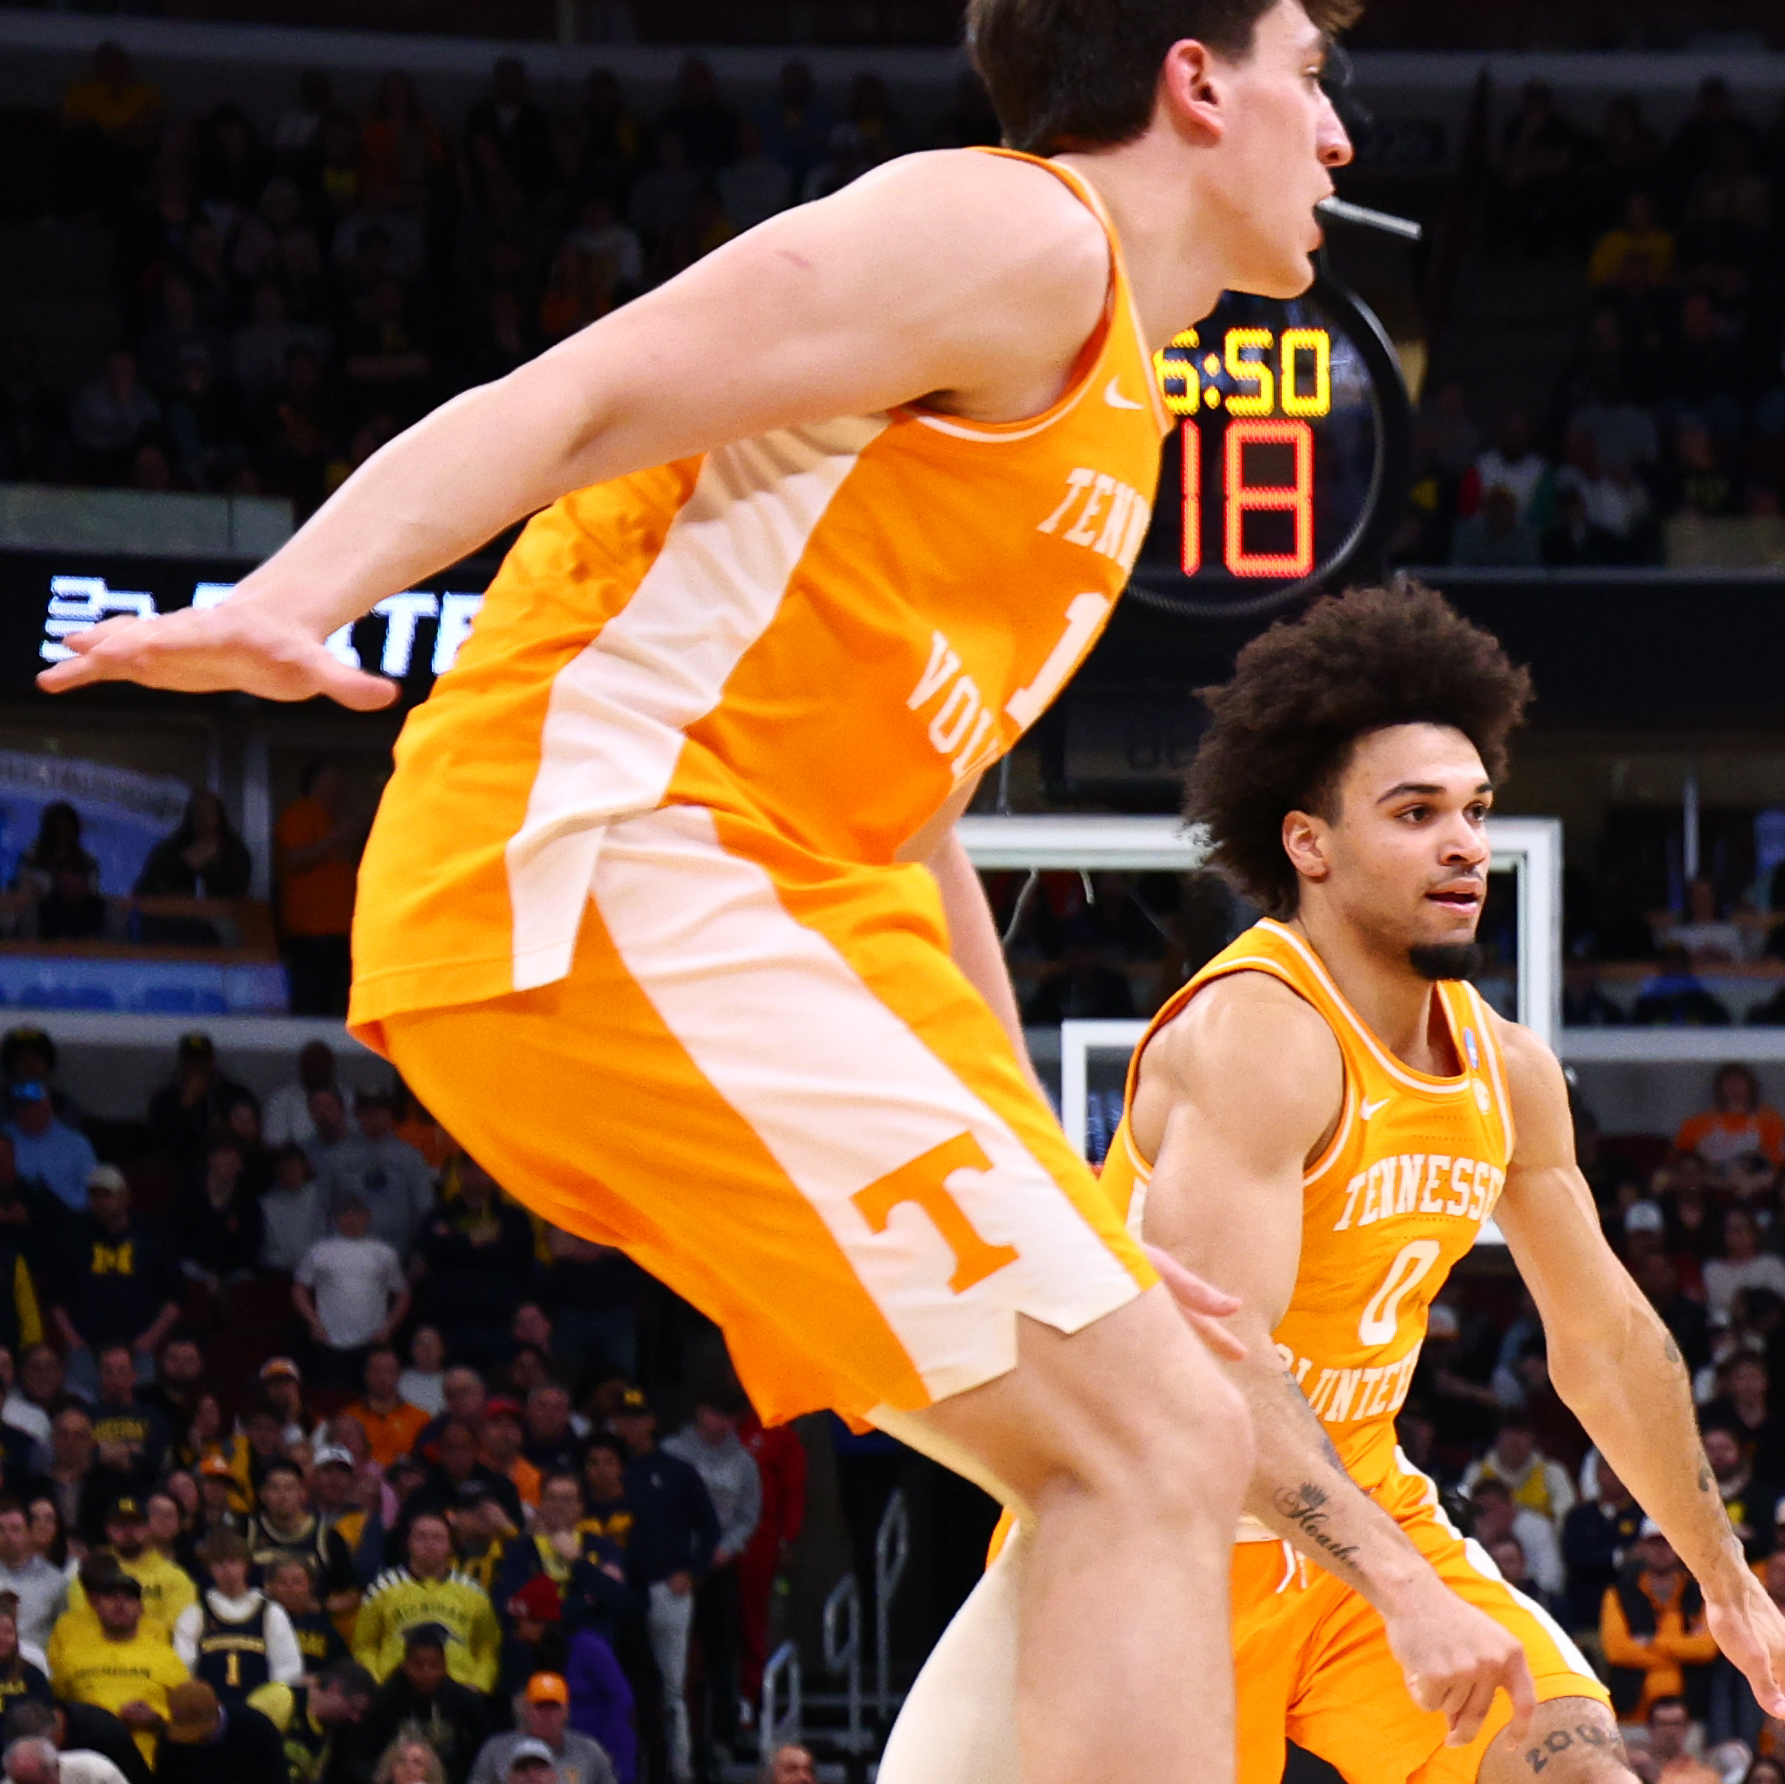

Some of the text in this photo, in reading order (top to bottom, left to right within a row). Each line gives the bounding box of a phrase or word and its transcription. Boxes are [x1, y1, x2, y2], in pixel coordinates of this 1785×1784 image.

[1152, 327, 1330, 417] 6:50
[1180, 418, 1316, 579] 18
[1004, 592, 1110, 734] 1
[850, 1129, 1020, 1295] T
[1358, 1238, 1441, 1347] 0
